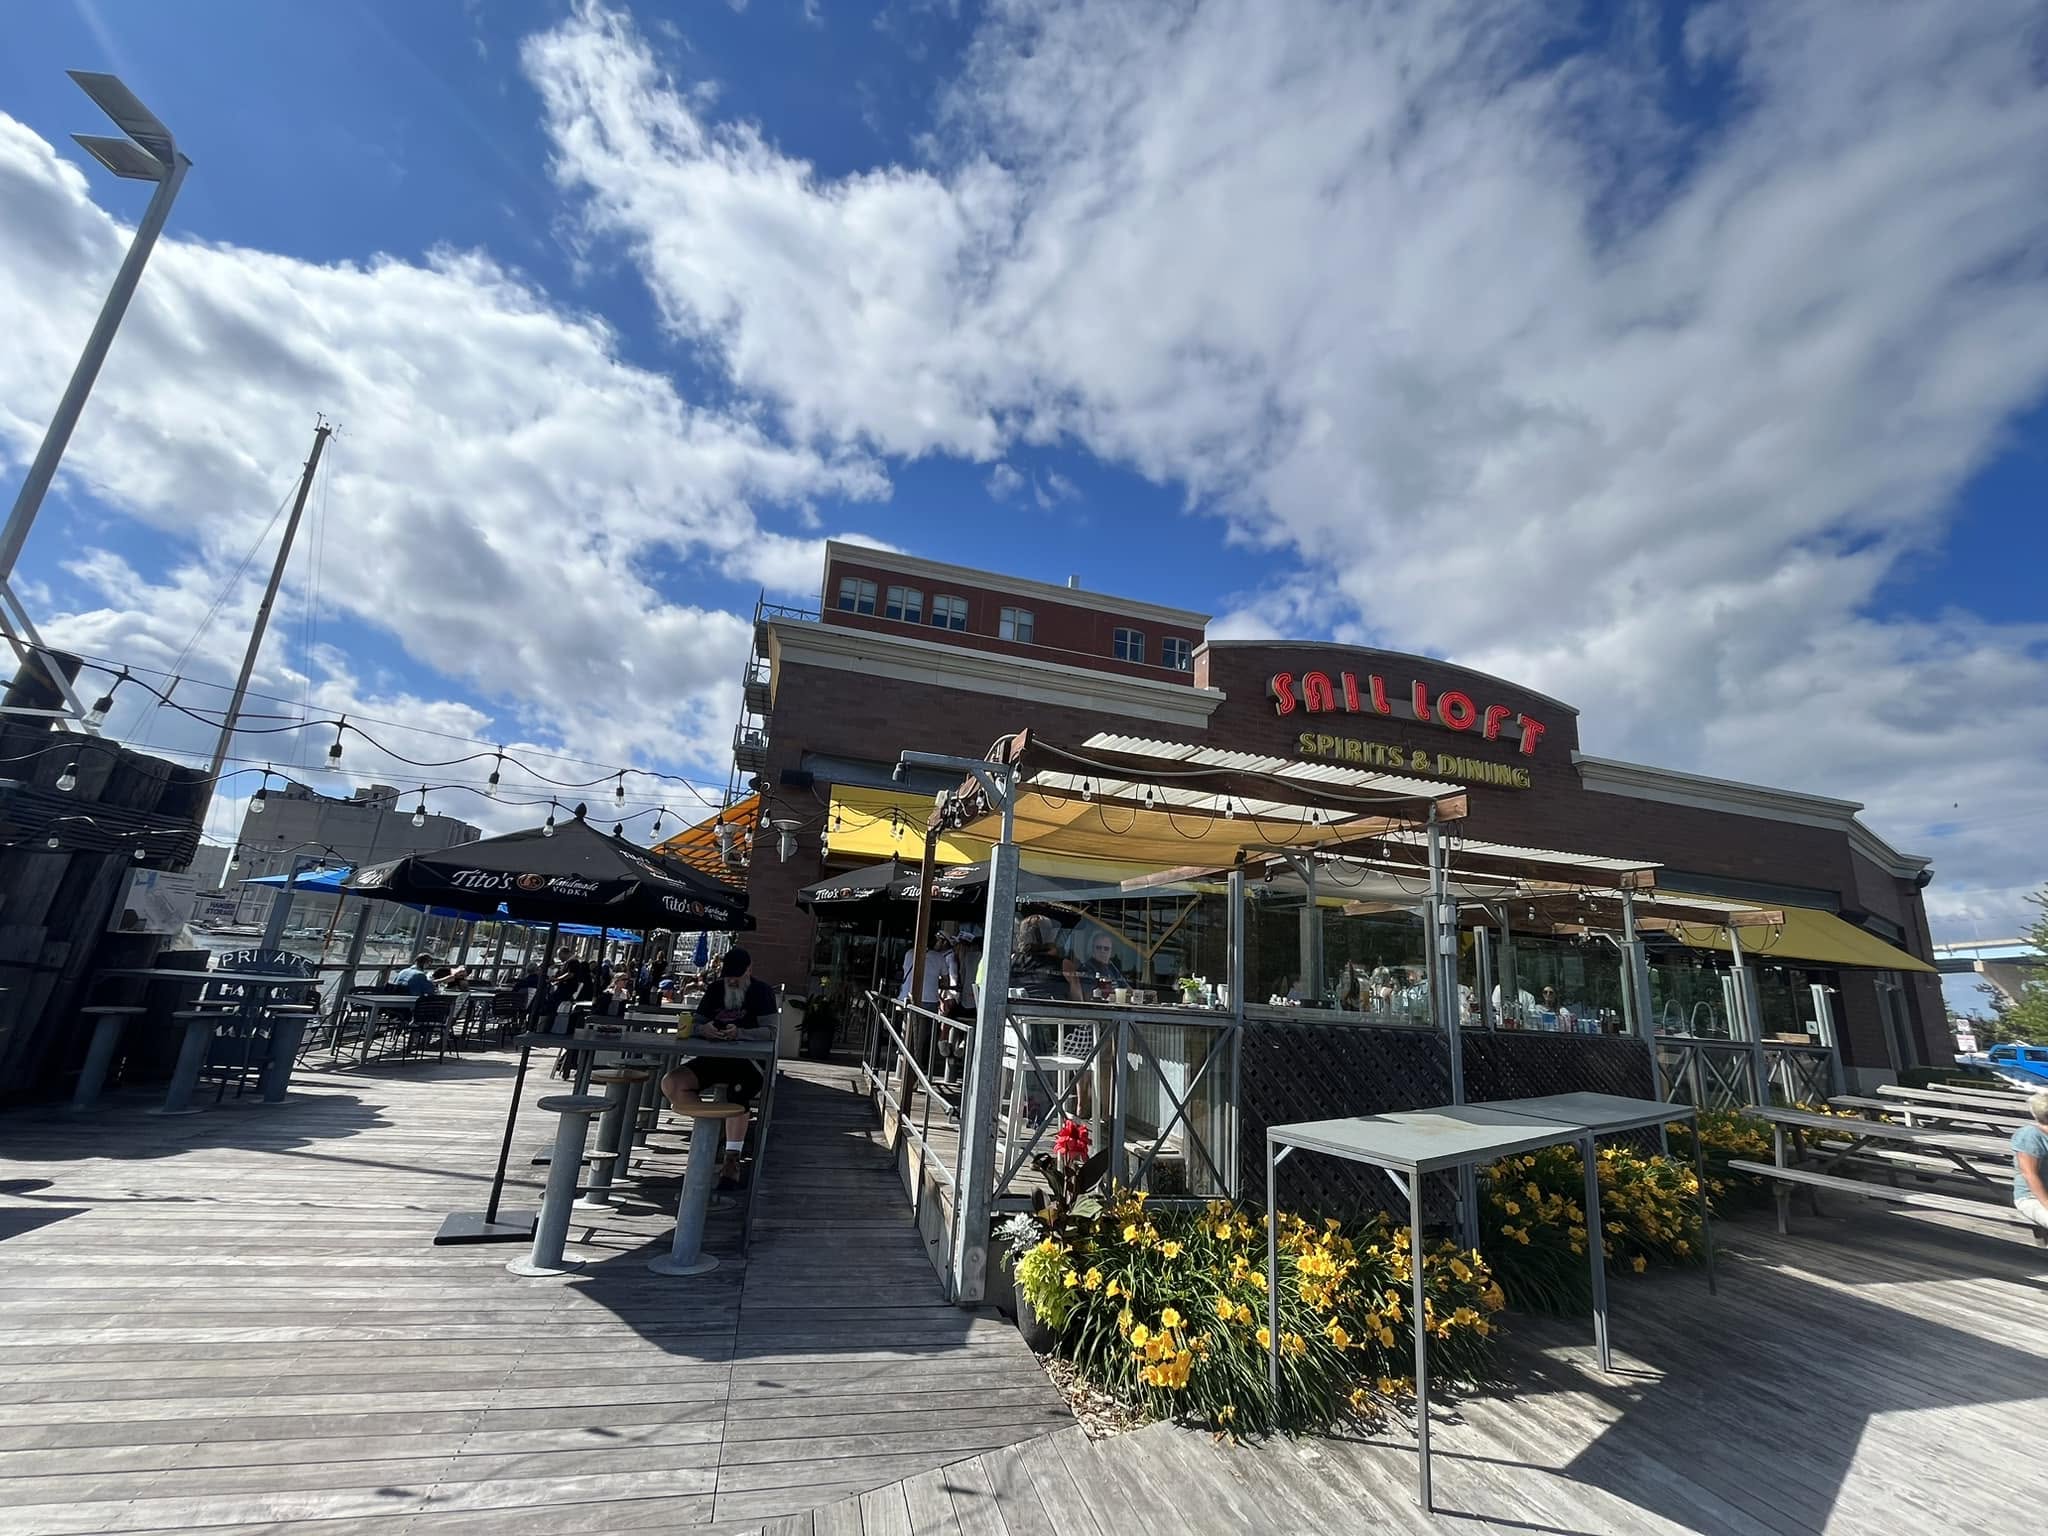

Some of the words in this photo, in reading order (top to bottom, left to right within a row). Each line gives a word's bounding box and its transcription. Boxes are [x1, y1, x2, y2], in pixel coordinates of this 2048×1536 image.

[1271, 671, 1391, 716] SAIL
[1411, 679, 1545, 756] LOFT
[1299, 732, 1404, 769] SPIRITS
[1411, 749, 1431, 773] &
[1437, 753, 1531, 788] DINING
[452, 869, 513, 890] Tito's
[552, 886, 588, 897] VODKA
[901, 885, 921, 897] Tito
[662, 895, 691, 912] Tito's
